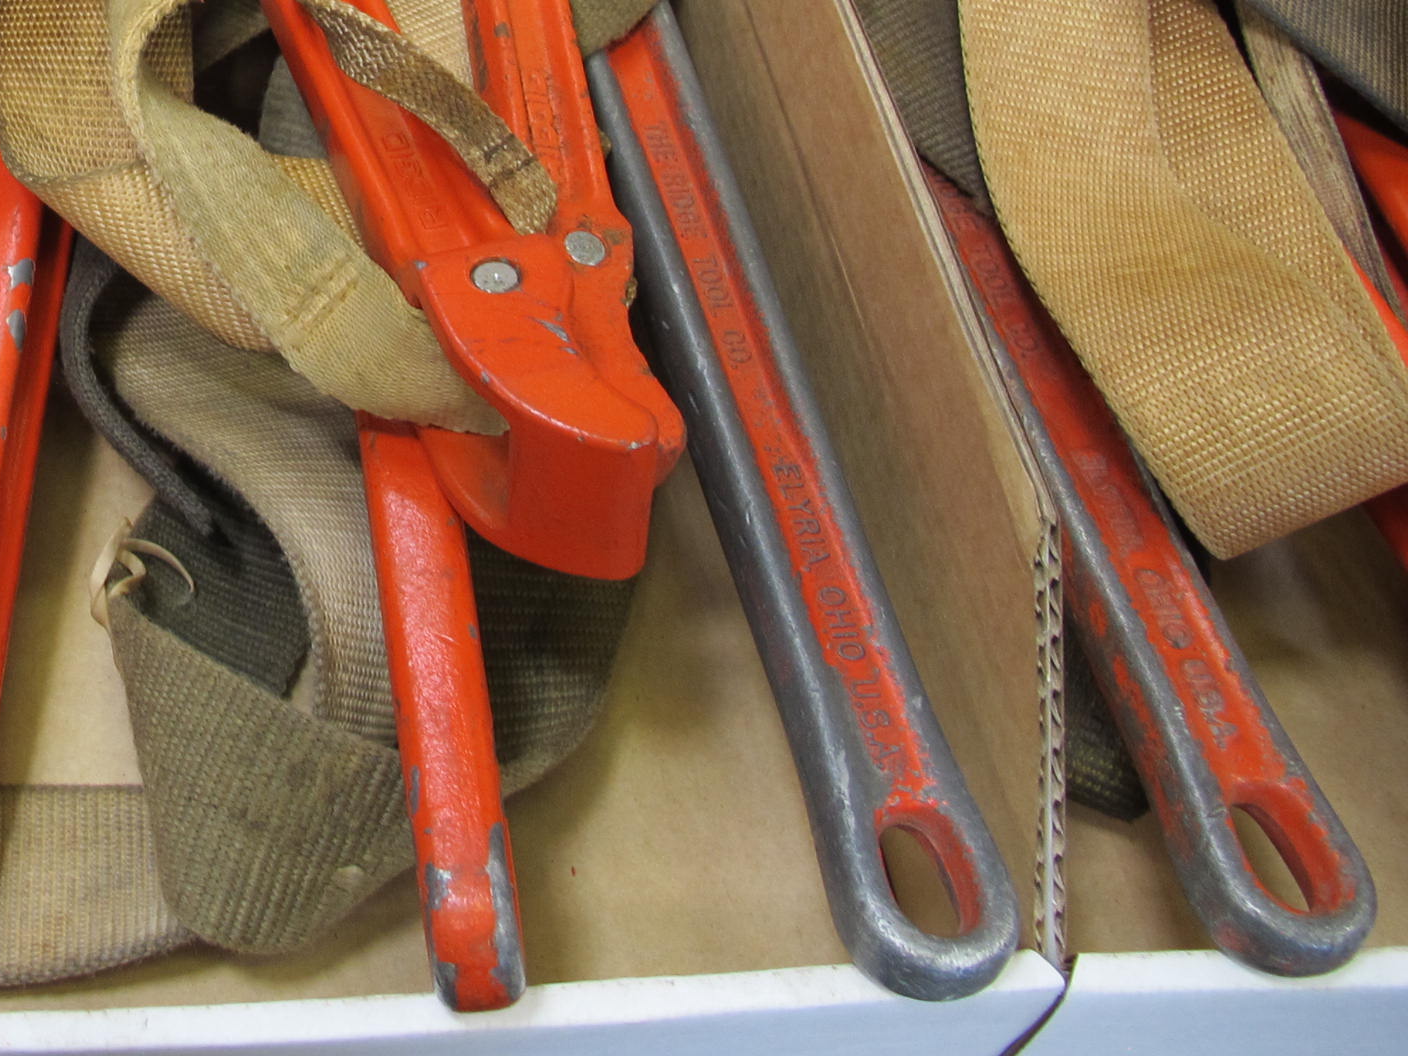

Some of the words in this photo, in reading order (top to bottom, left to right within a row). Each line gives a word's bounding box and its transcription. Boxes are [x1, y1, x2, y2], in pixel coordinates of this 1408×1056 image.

[644, 119, 679, 164] THE
[661, 170, 708, 240] RIDGE
[693, 252, 735, 319] TOOL
[773, 461, 832, 574] ELYRIA,
[817, 586, 867, 663] OHIO
